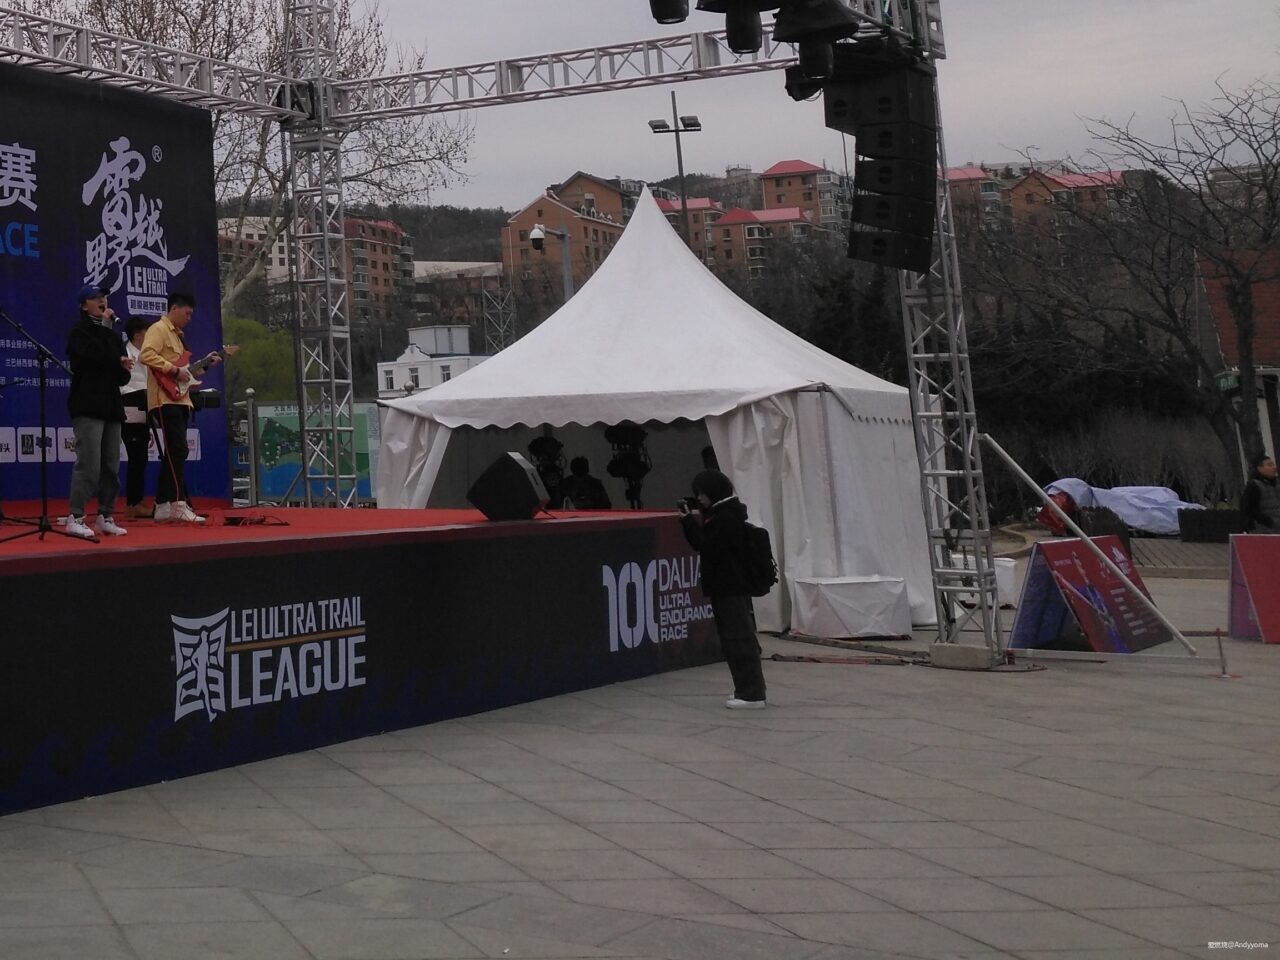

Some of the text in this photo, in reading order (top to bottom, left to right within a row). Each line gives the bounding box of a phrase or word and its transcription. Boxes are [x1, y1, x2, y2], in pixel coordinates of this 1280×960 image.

[126, 265, 167, 294] LEI ULTRA
[148, 281, 168, 295] TRAIL
[658, 554, 702, 592] DALIA
[659, 592, 692, 610] ULTRA
[231, 595, 366, 644] LEI ULTRA TRAIL
[660, 604, 715, 627] ENDURANC
[660, 623, 688, 643] RACE
[231, 634, 367, 709] LEAGUE
